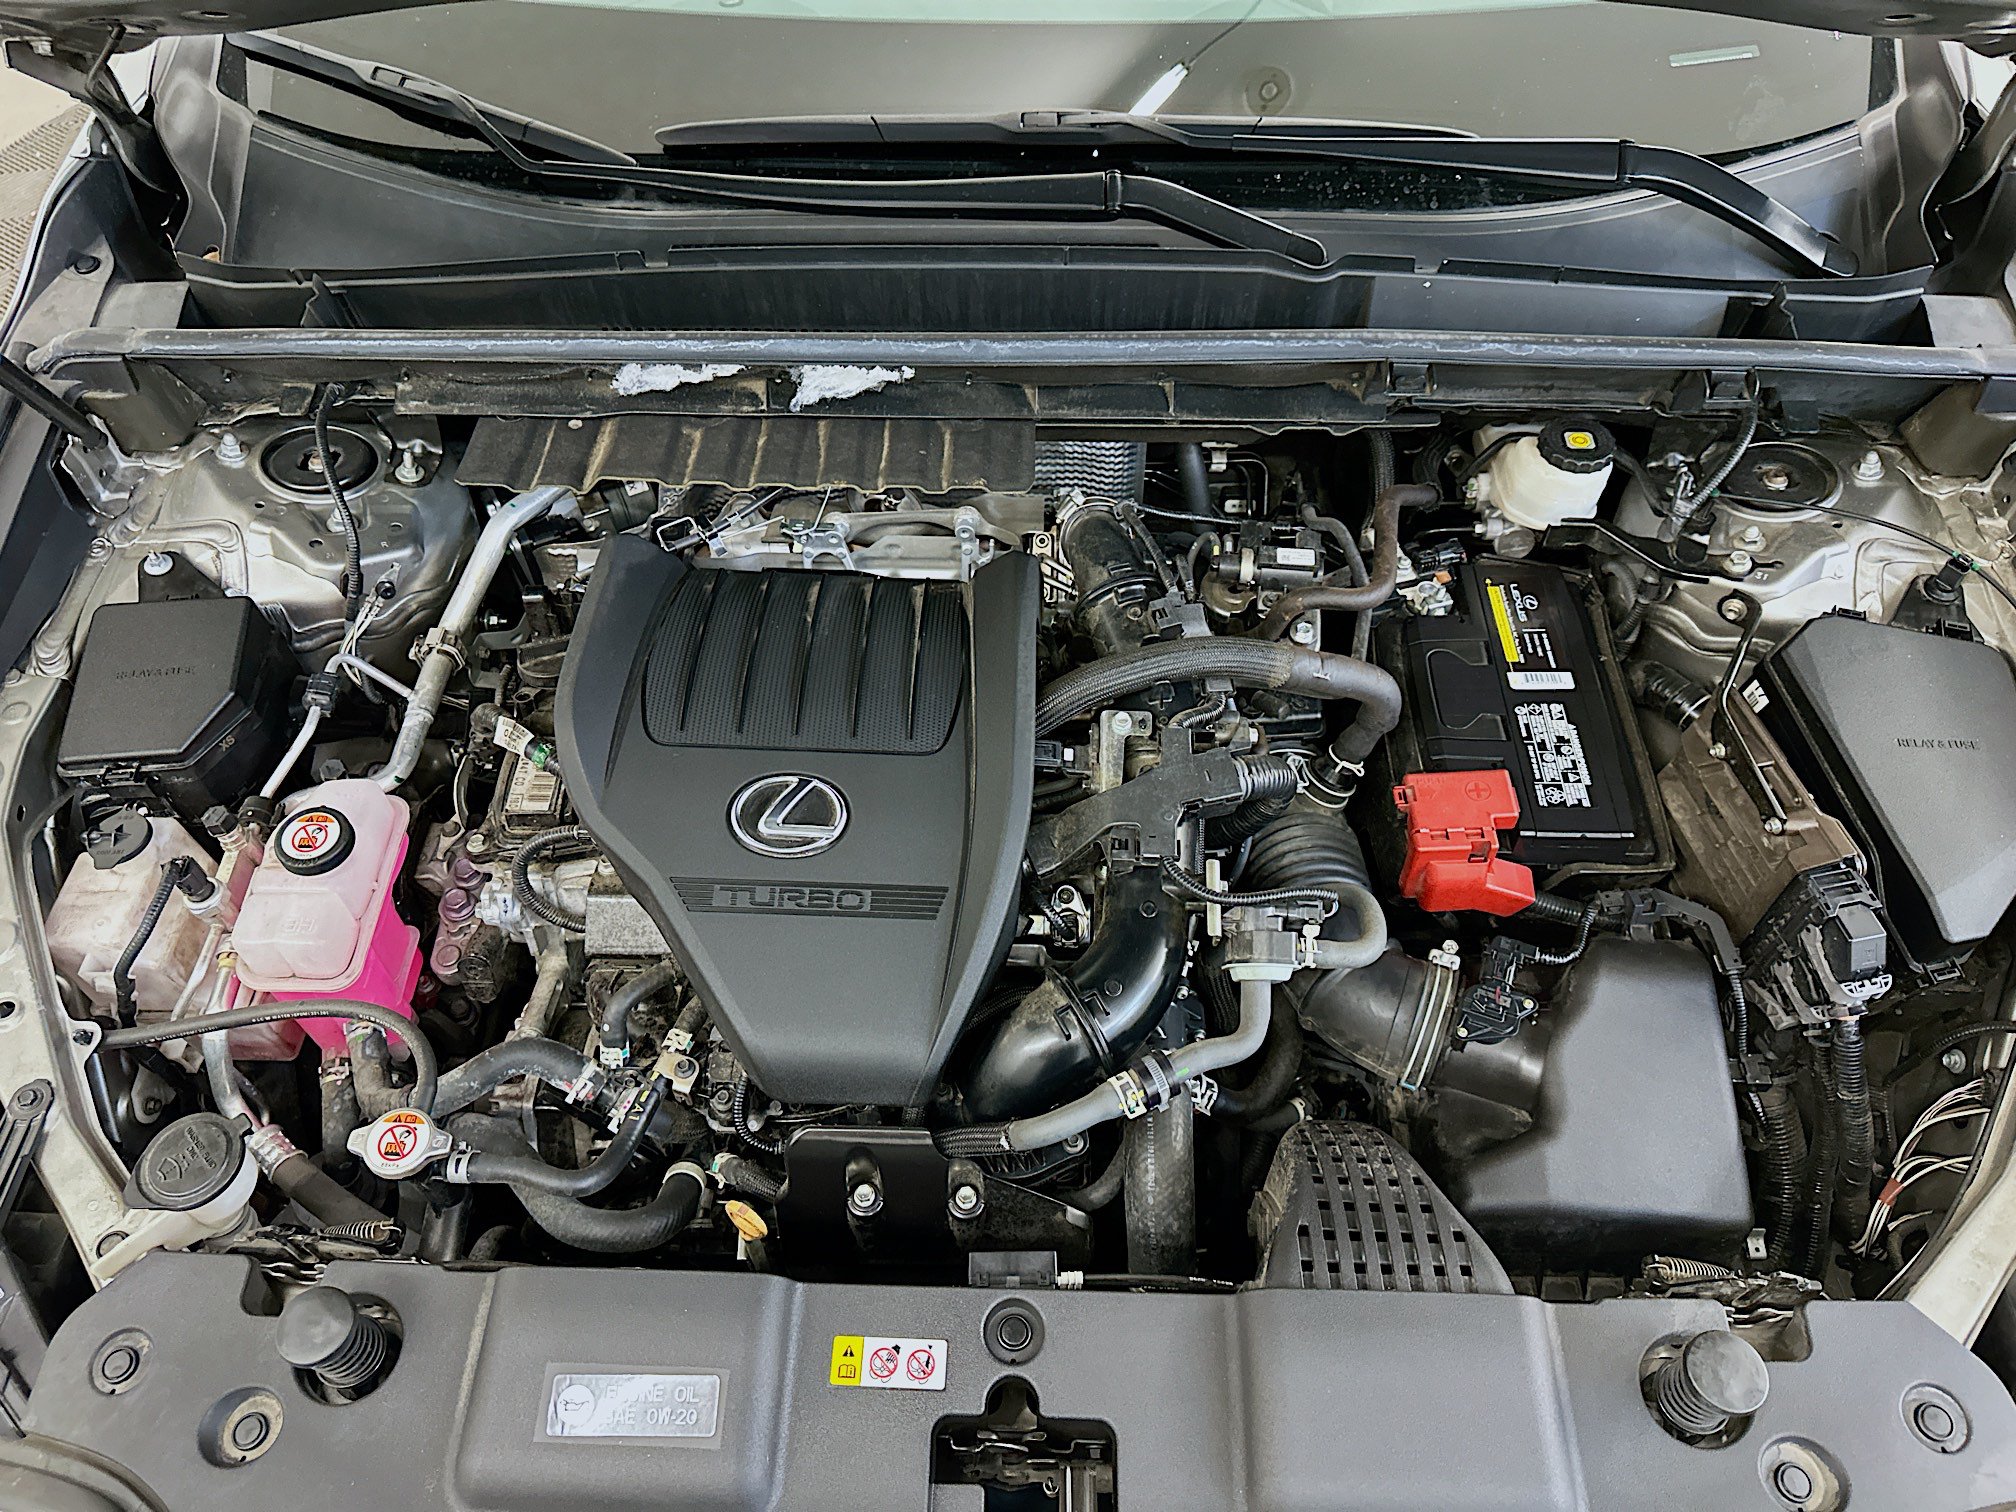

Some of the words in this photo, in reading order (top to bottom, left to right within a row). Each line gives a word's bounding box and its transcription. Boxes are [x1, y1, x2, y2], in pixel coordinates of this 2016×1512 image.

[1509, 583, 1529, 622] LEXUS
[1896, 738, 1935, 749] RELAY
[718, 885, 865, 912] TURBO
[605, 1385, 664, 1403] EINE
[675, 1386, 701, 1404] OIL
[646, 1409, 698, 1425] 0W-20
